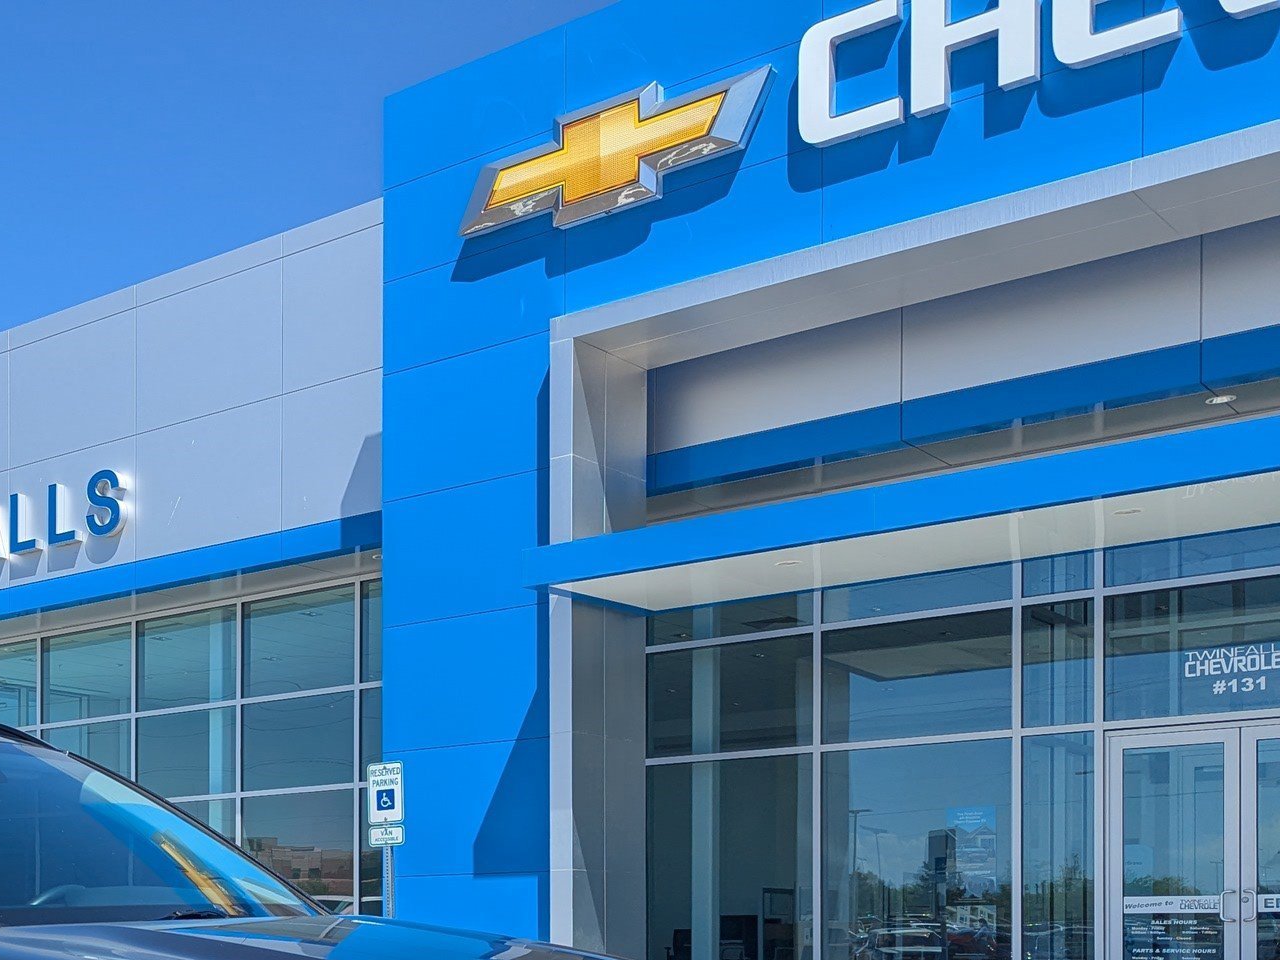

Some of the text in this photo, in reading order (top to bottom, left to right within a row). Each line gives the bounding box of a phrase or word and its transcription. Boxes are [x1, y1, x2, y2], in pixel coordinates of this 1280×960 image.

[798, 0, 1280, 148] CH
[1212, 676, 1266, 695] #131
[370, 767, 401, 777] RESERVED
[372, 778, 399, 788] PARKING
[1125, 902, 1163, 910] Welcome
